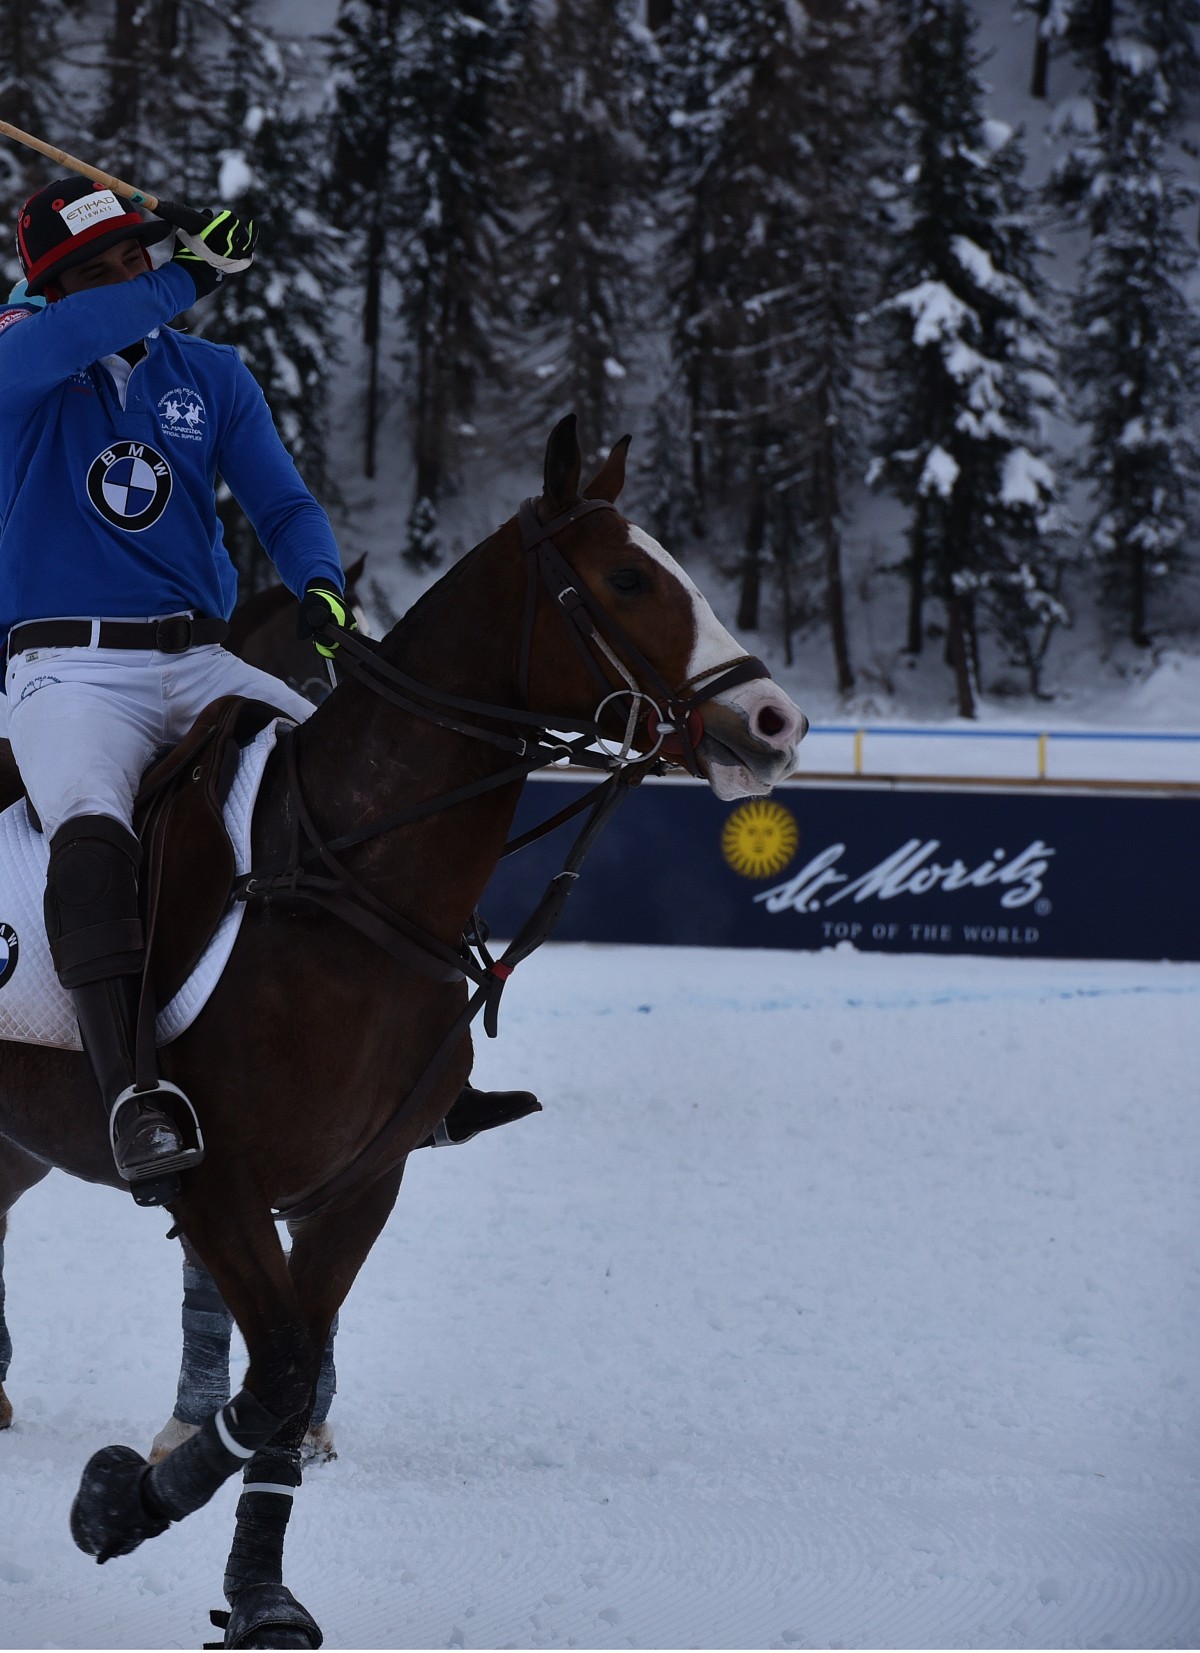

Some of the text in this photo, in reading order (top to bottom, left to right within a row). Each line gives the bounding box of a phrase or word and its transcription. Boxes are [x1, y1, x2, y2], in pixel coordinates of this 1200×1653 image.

[67, 197, 115, 220] ETIHAD
[80, 206, 112, 222] AIRWAYS
[170, 425, 203, 436] MARTINA
[100, 443, 169, 477] BMW
[825, 839, 1056, 909] Moritz
[822, 921, 1040, 944] TOP OF THE WORLD
